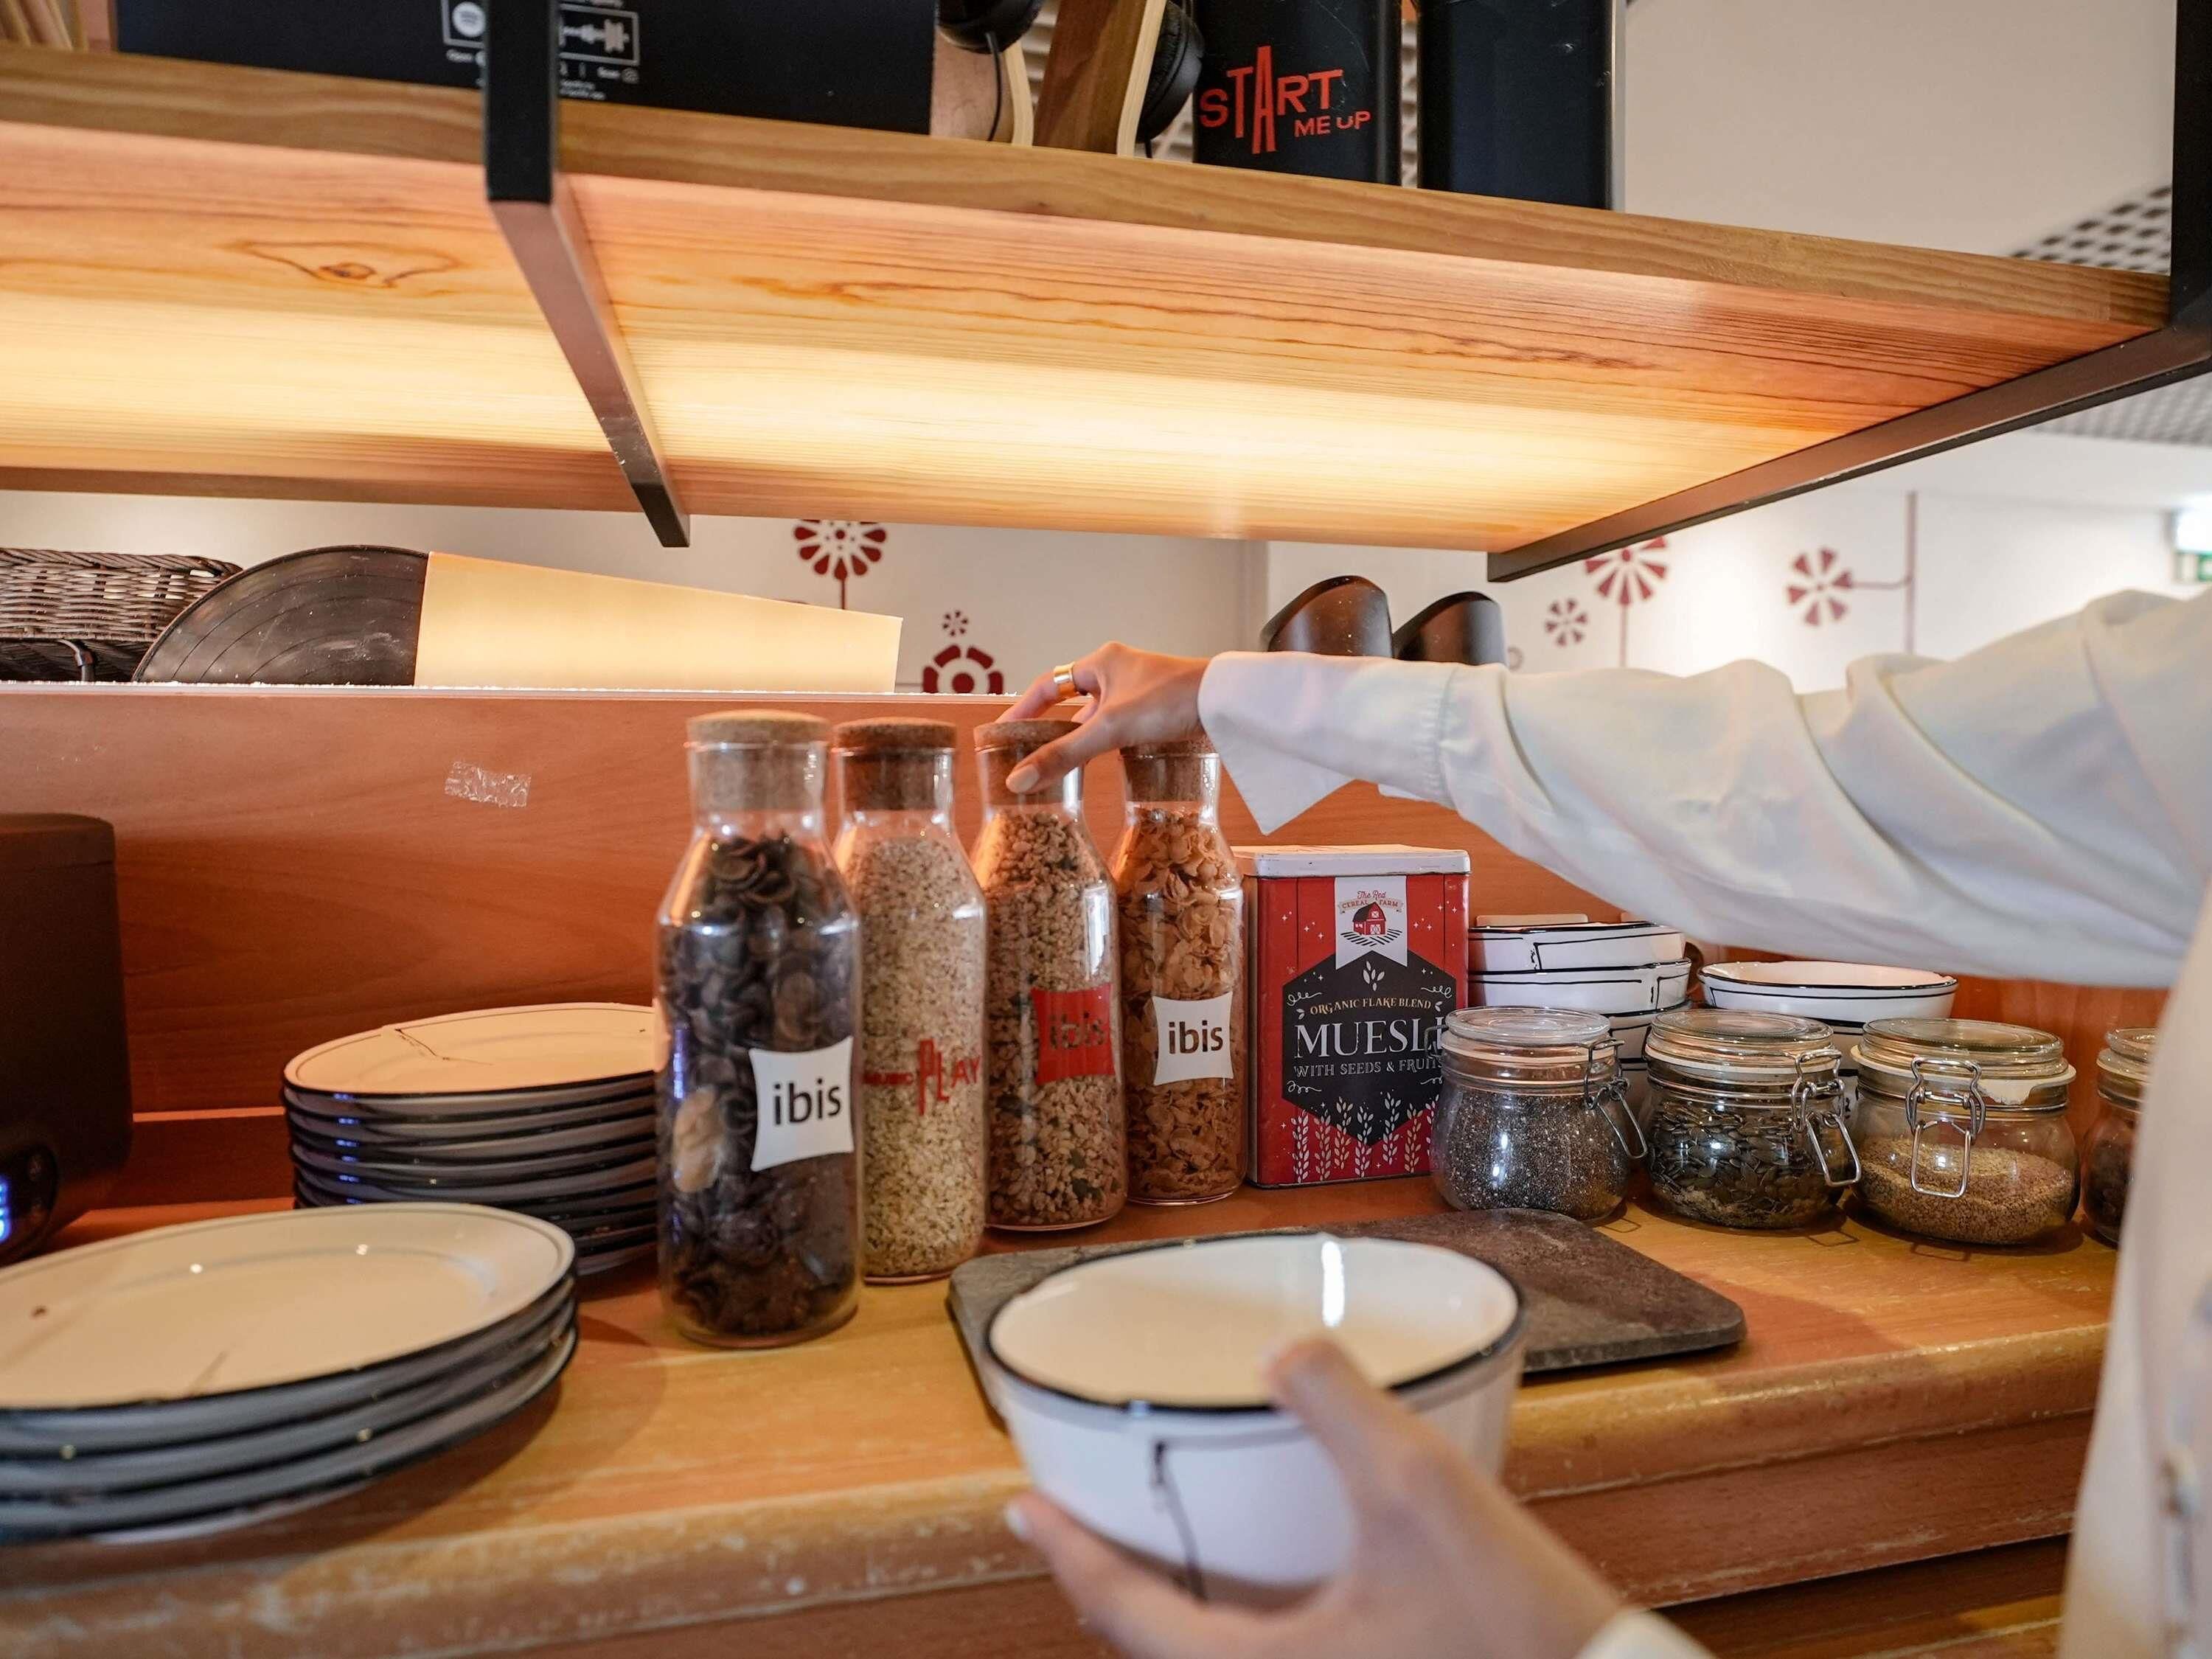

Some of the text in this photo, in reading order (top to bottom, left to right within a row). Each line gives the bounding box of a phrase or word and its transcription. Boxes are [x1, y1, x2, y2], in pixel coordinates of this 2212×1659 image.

[1200, 45, 1344, 155] START
[1294, 111, 1371, 138] ME UP
[1342, 899, 1399, 909] CEREAL FARM
[1357, 889, 1386, 900] The Red
[1310, 997, 1432, 1015] ORGANIC FLAKE BLEND
[1048, 1011, 1105, 1050] ibis
[1168, 1020, 1224, 1055] ibis
[1293, 1017, 1444, 1059] MUESLI
[1293, 1064, 1335, 1078] WITH
[1340, 1061, 1382, 1076] SEEDS
[1385, 1061, 1395, 1073] &
[774, 1077, 841, 1126] ibis
